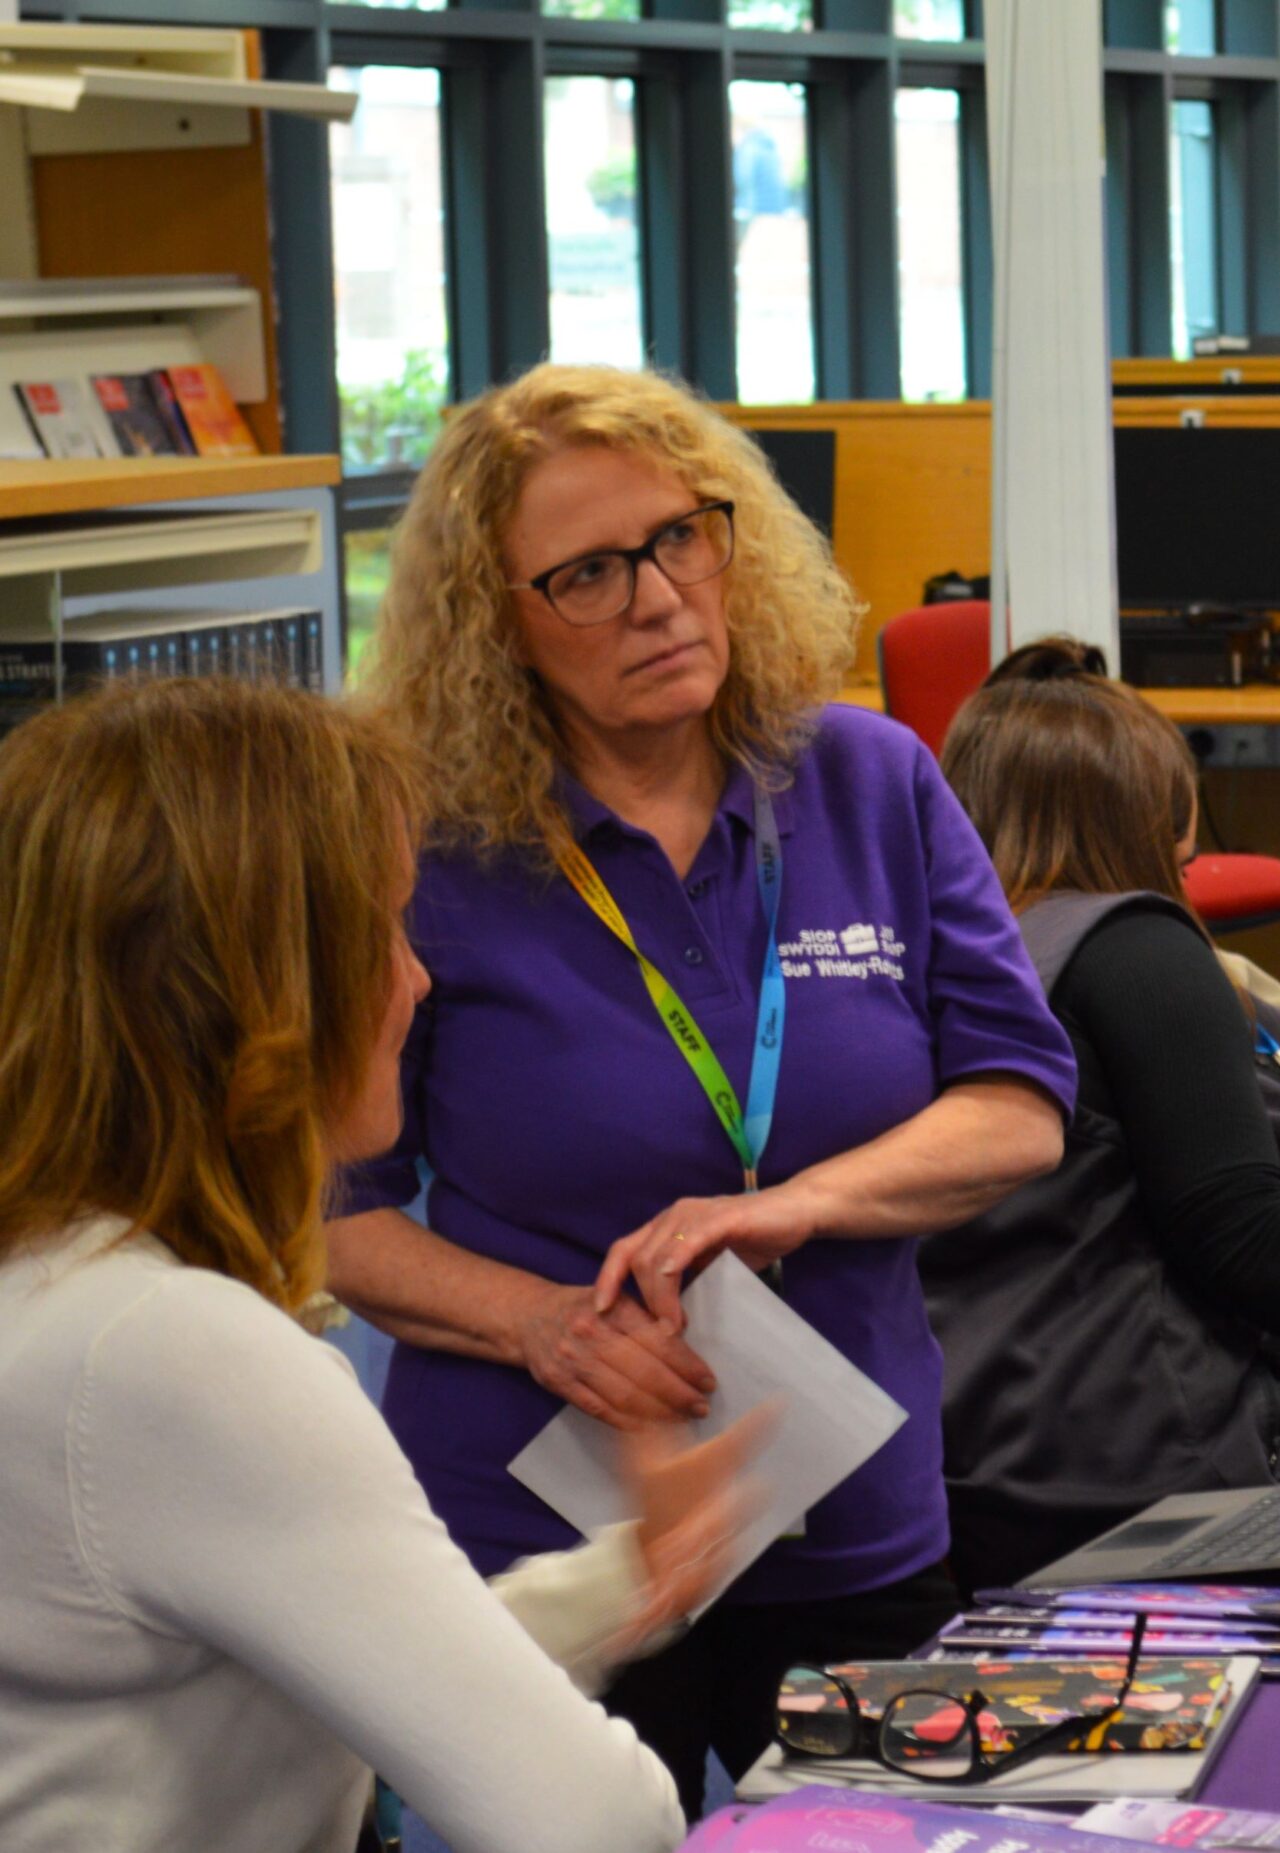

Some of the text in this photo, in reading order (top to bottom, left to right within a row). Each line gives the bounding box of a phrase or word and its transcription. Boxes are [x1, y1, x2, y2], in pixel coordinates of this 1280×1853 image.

[798, 928, 837, 943] SIOP
[777, 942, 841, 957] SWYDDI
[780, 959, 812, 978] Sue
[668, 1009, 702, 1052] STAFF
